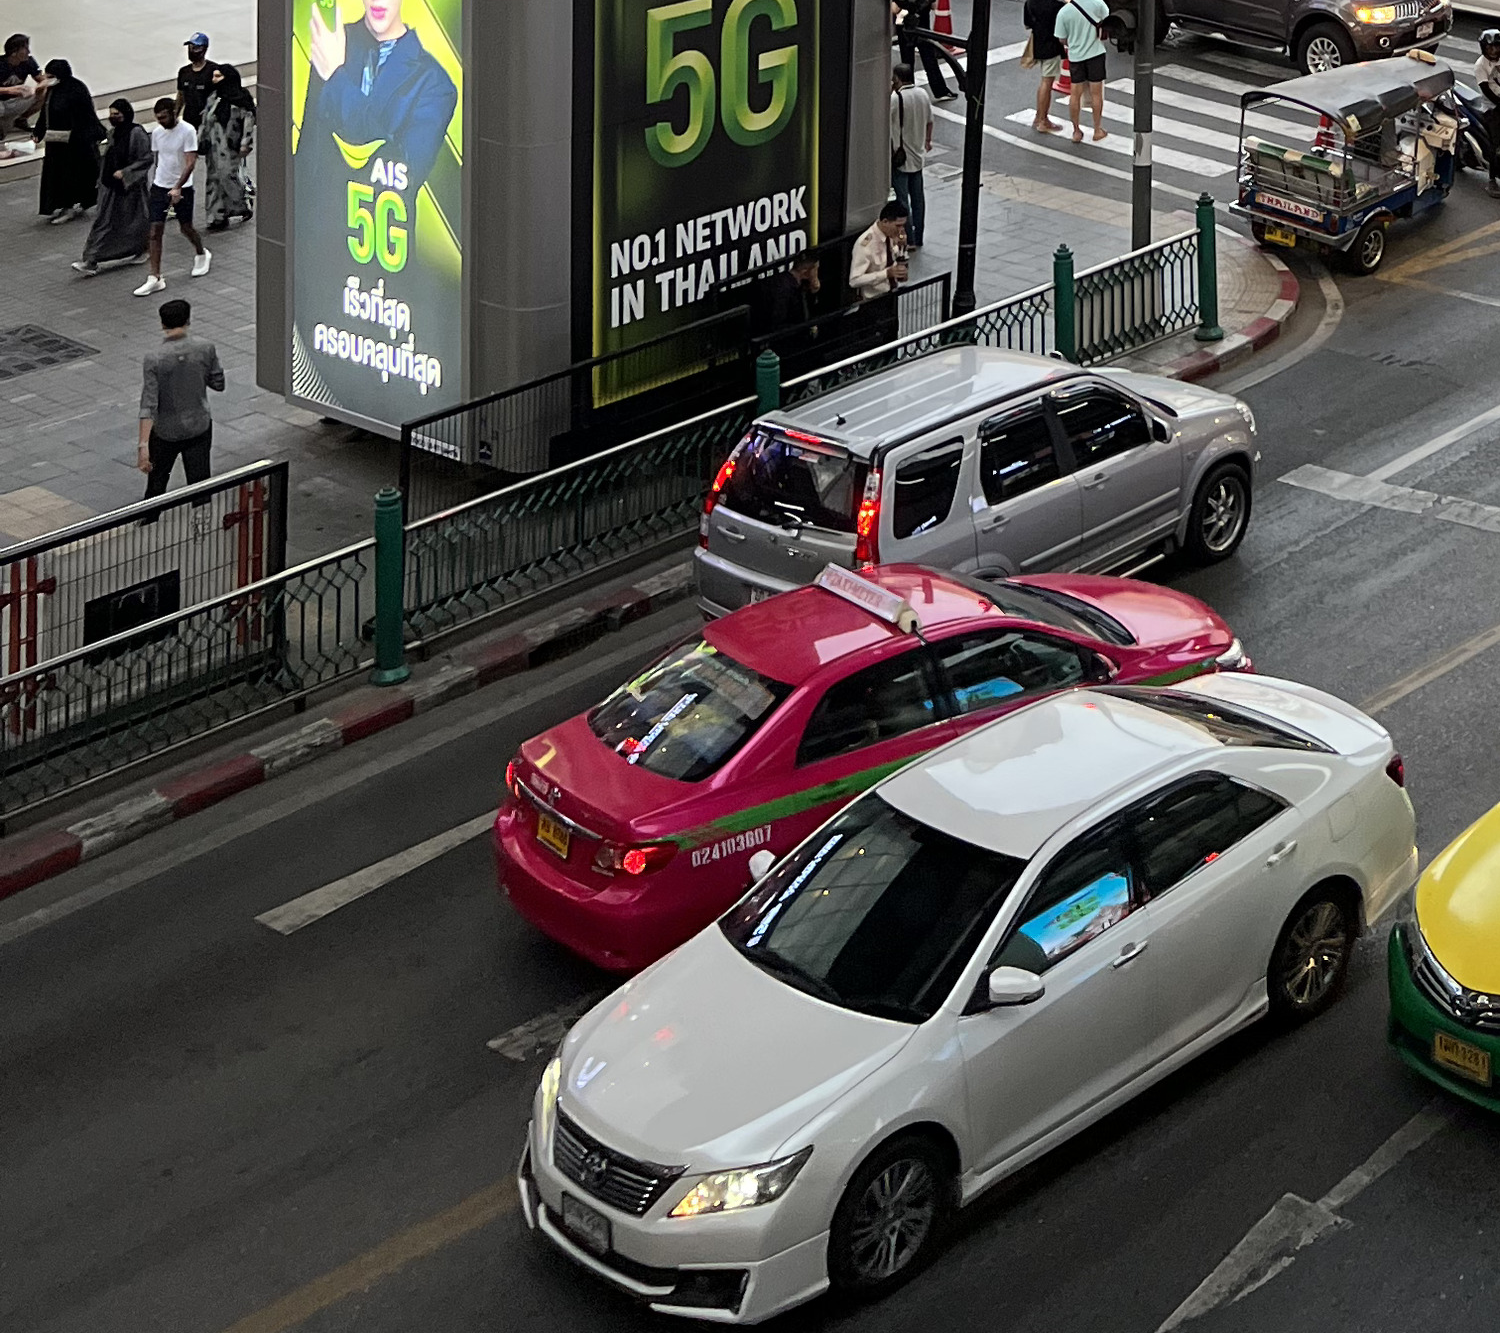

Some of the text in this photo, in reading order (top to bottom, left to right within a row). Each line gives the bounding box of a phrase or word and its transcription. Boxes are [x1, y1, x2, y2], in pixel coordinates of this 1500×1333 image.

[370, 157, 408, 190] AIS
[347, 180, 408, 273] 5G
[611, 185, 807, 279] NO.1 NETWORK
[1260, 193, 1319, 219] THAILAND
[343, 276, 411, 340] เร็วที่สุด
[611, 279, 645, 329] IN
[314, 322, 442, 396] ครอบคลุมที่สุด
